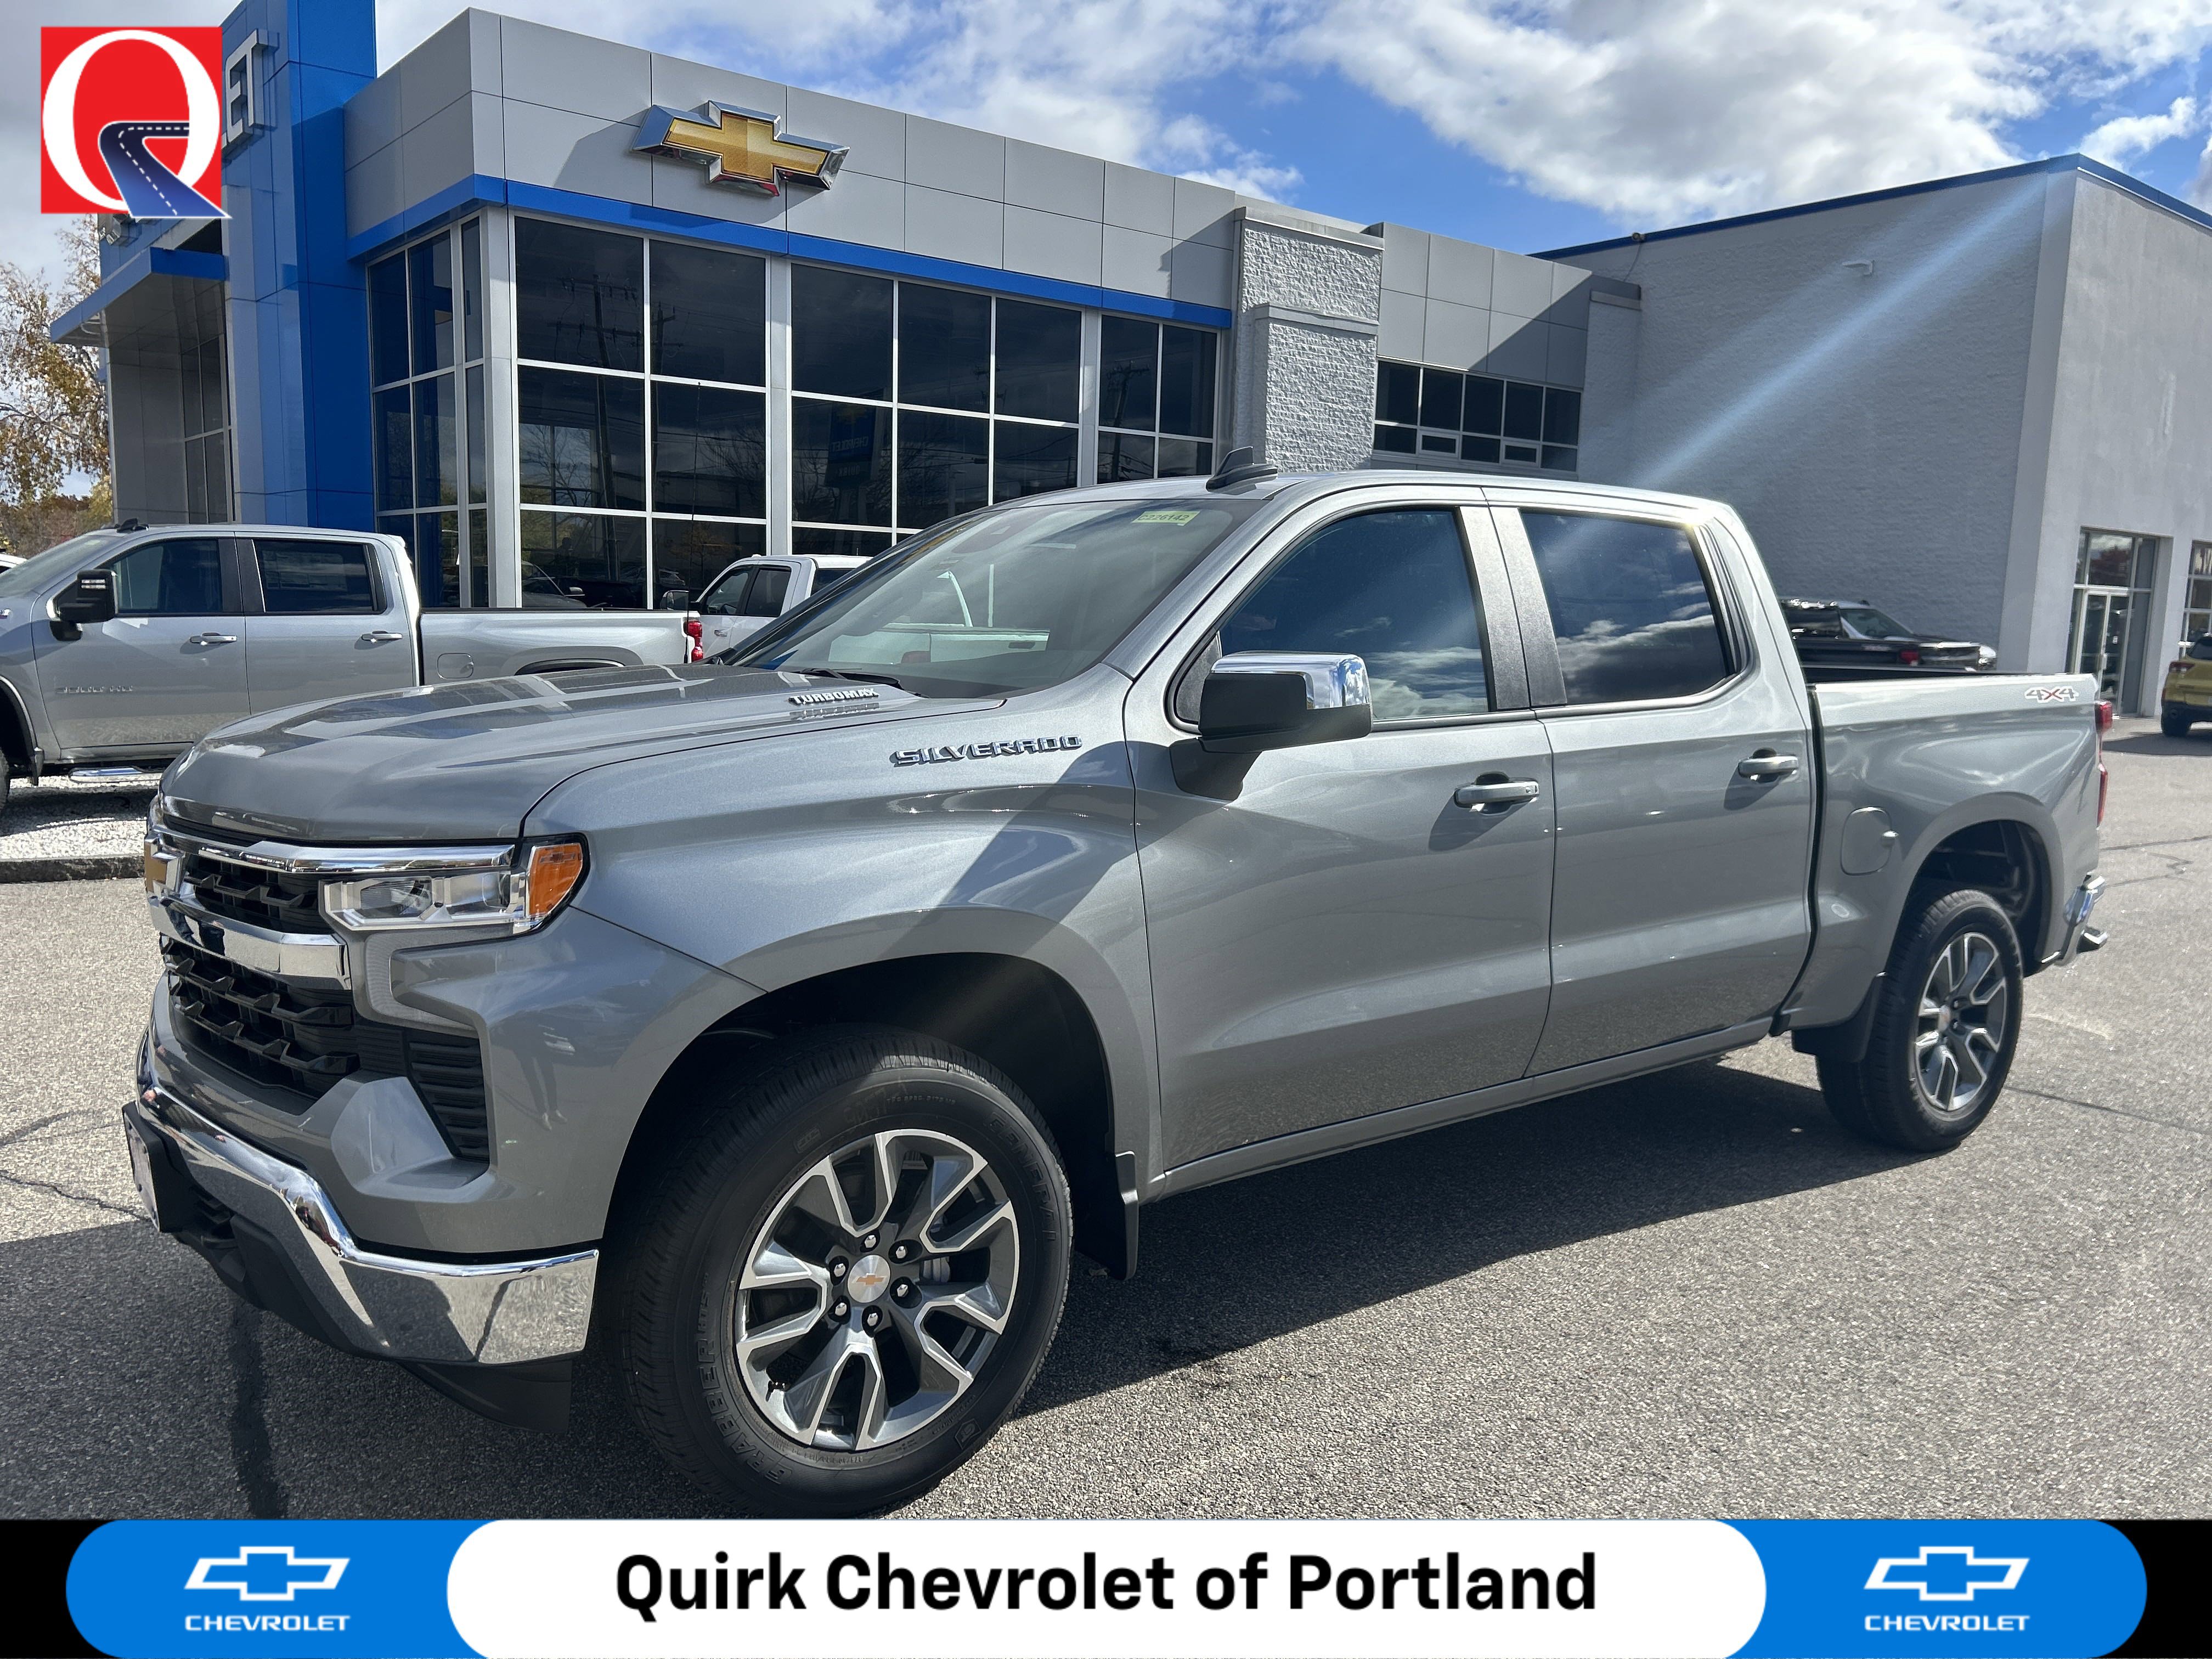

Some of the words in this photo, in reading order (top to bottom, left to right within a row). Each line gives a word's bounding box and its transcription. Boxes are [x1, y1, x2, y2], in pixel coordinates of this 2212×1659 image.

[789, 688, 879, 706] TURBOMAX
[895, 735, 1083, 765] SILVERADO
[984, 1112, 1057, 1241] GENERAL
[697, 1338, 792, 1485] GRABBER
